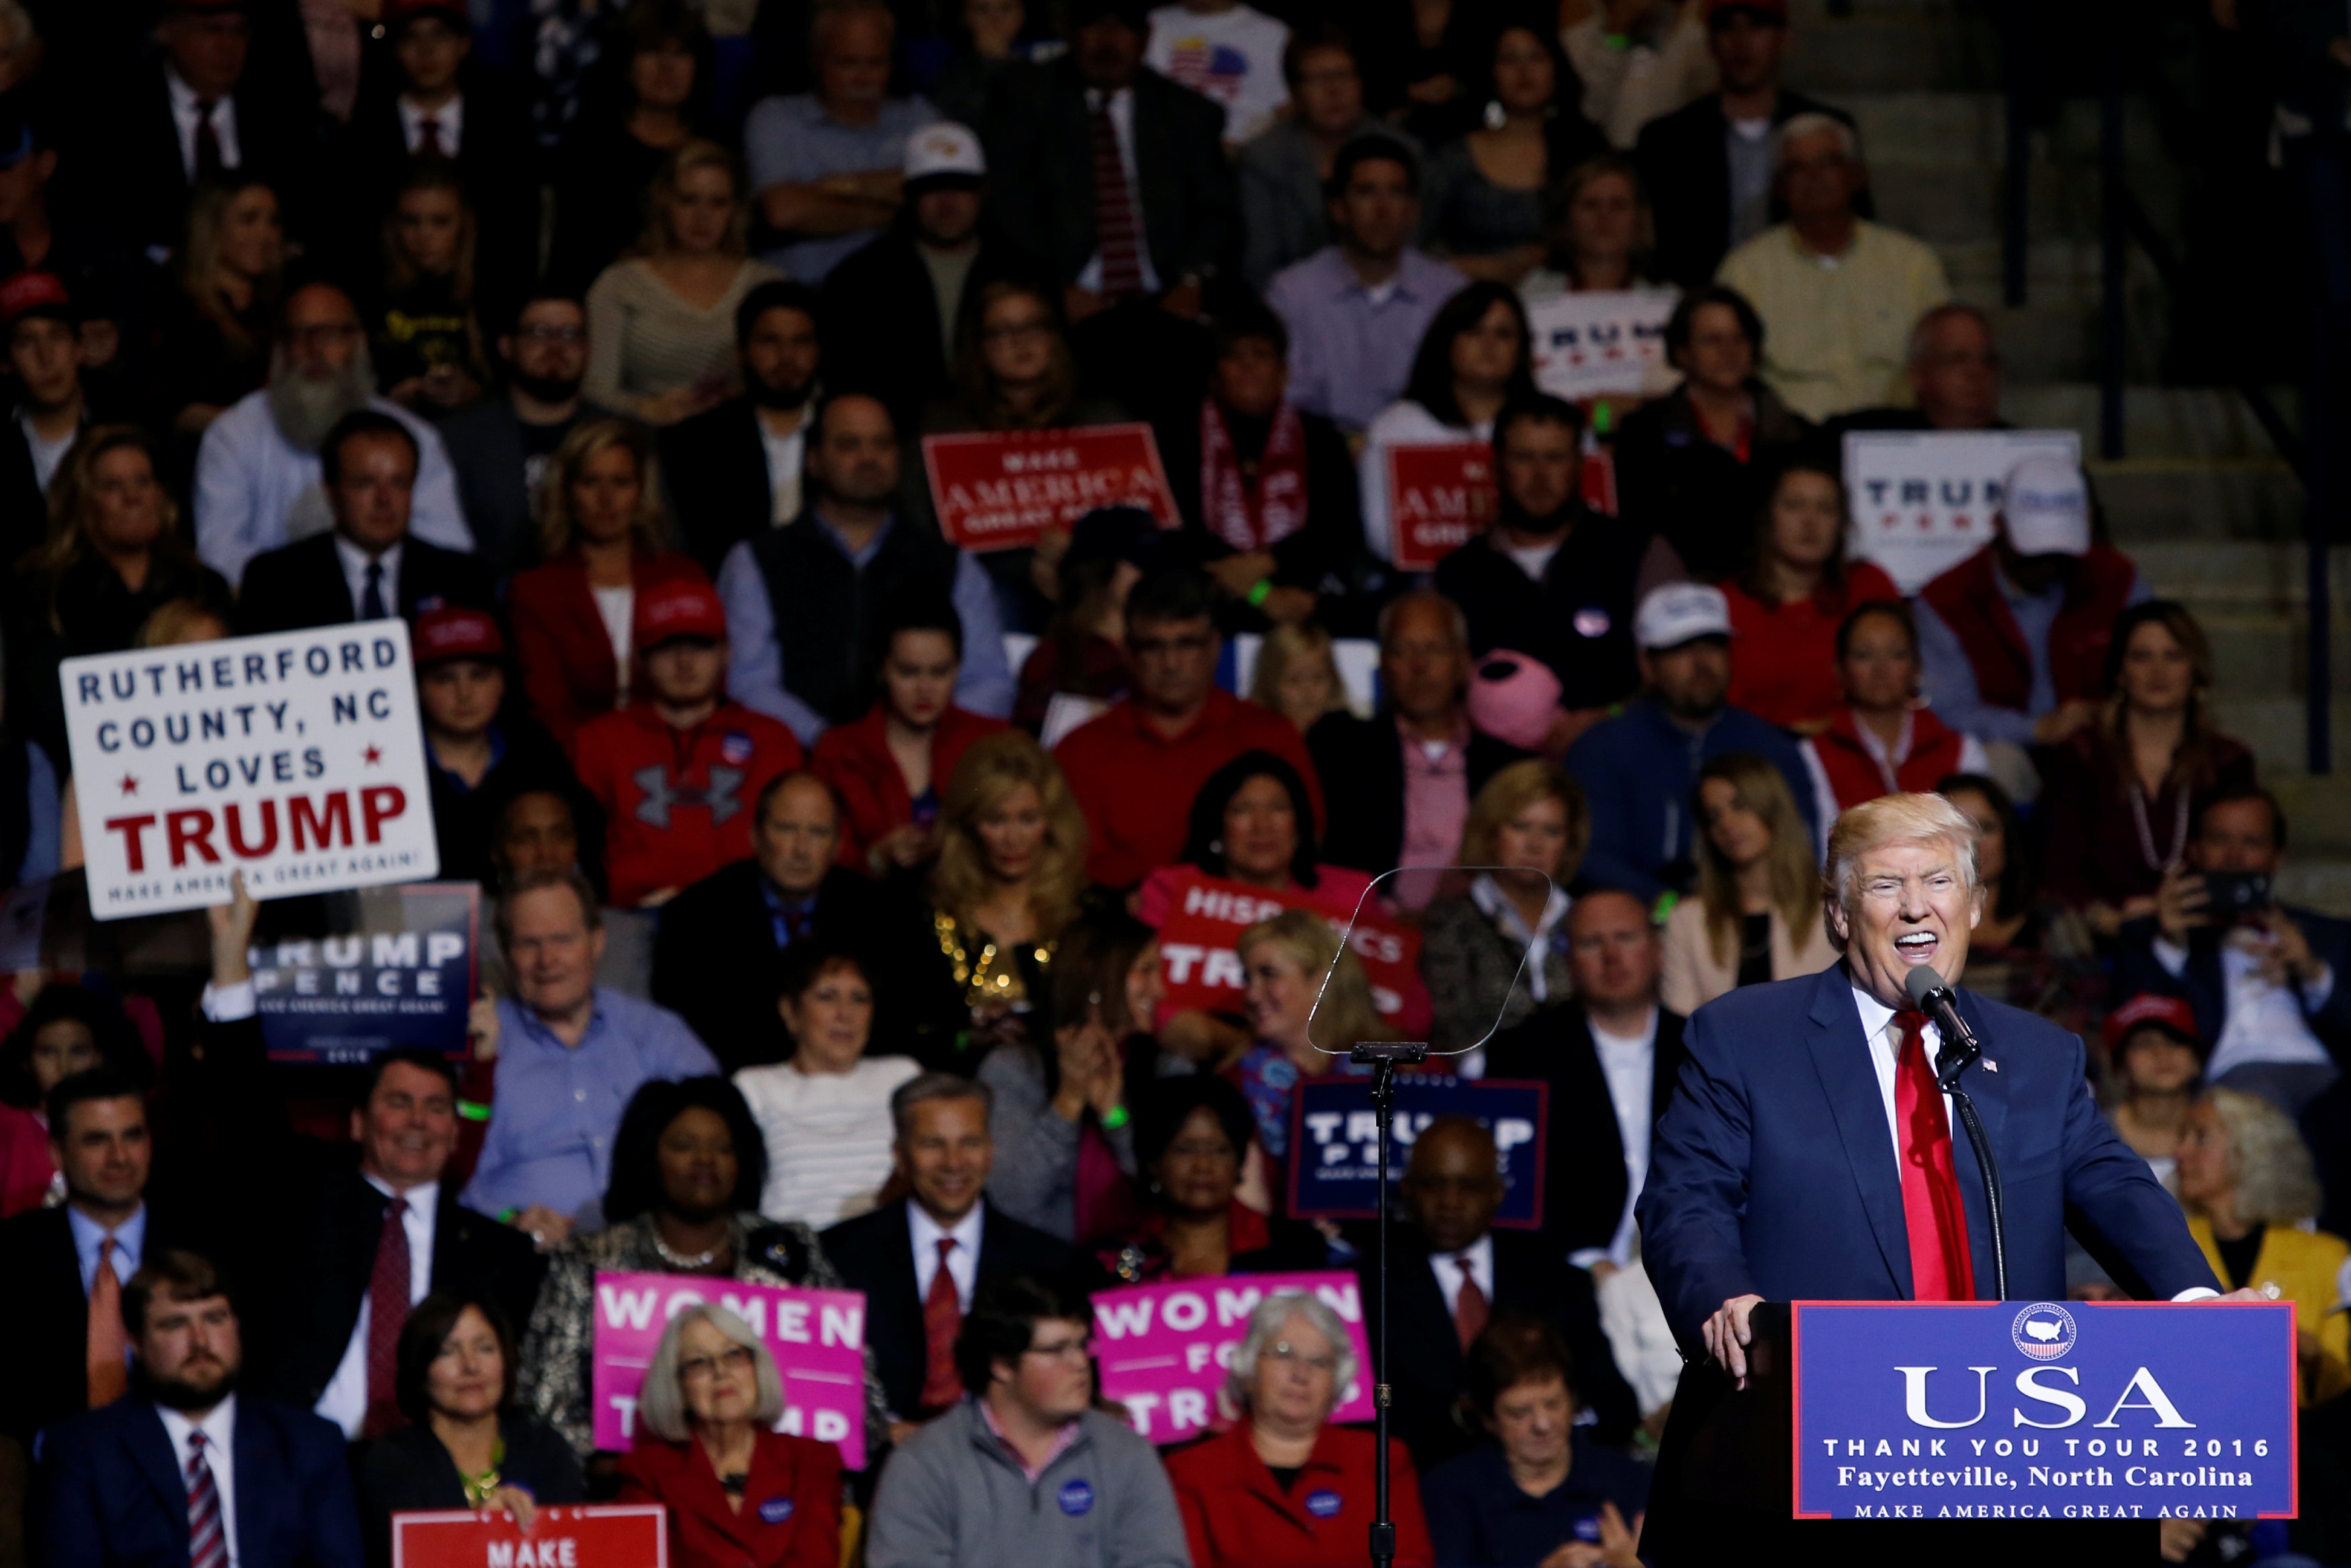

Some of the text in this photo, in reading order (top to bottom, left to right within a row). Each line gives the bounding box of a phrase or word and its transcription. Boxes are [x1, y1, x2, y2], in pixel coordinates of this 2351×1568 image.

[945, 465, 1157, 512] AMERICA
[1865, 477, 2004, 507] TRU
[78, 637, 396, 706] RUTHERFORD
[97, 689, 391, 752] COUNTY, NC
[176, 747, 326, 795] LOVES
[105, 784, 407, 874] TRUMP
[108, 882, 163, 904] MAKE
[172, 871, 263, 894] AMERA
[275, 860, 338, 884] GREAT
[252, 968, 445, 997] PENCE
[1304, 1109, 1536, 1161] TRUP
[1094, 1282, 1363, 1340] WOMN
[1185, 1339, 1237, 1374] FO
[608, 1391, 851, 1444] TMP
[1894, 1365, 2197, 1429] USA
[1823, 1438, 2269, 1457] THANK YOU TOUR 2016
[1837, 1466, 2254, 1491] Fayetteville, North Carolina
[1854, 1504, 2238, 1518] MAKE AMERICA GREAT AGAIN
[488, 1537, 579, 1568] MAKE
